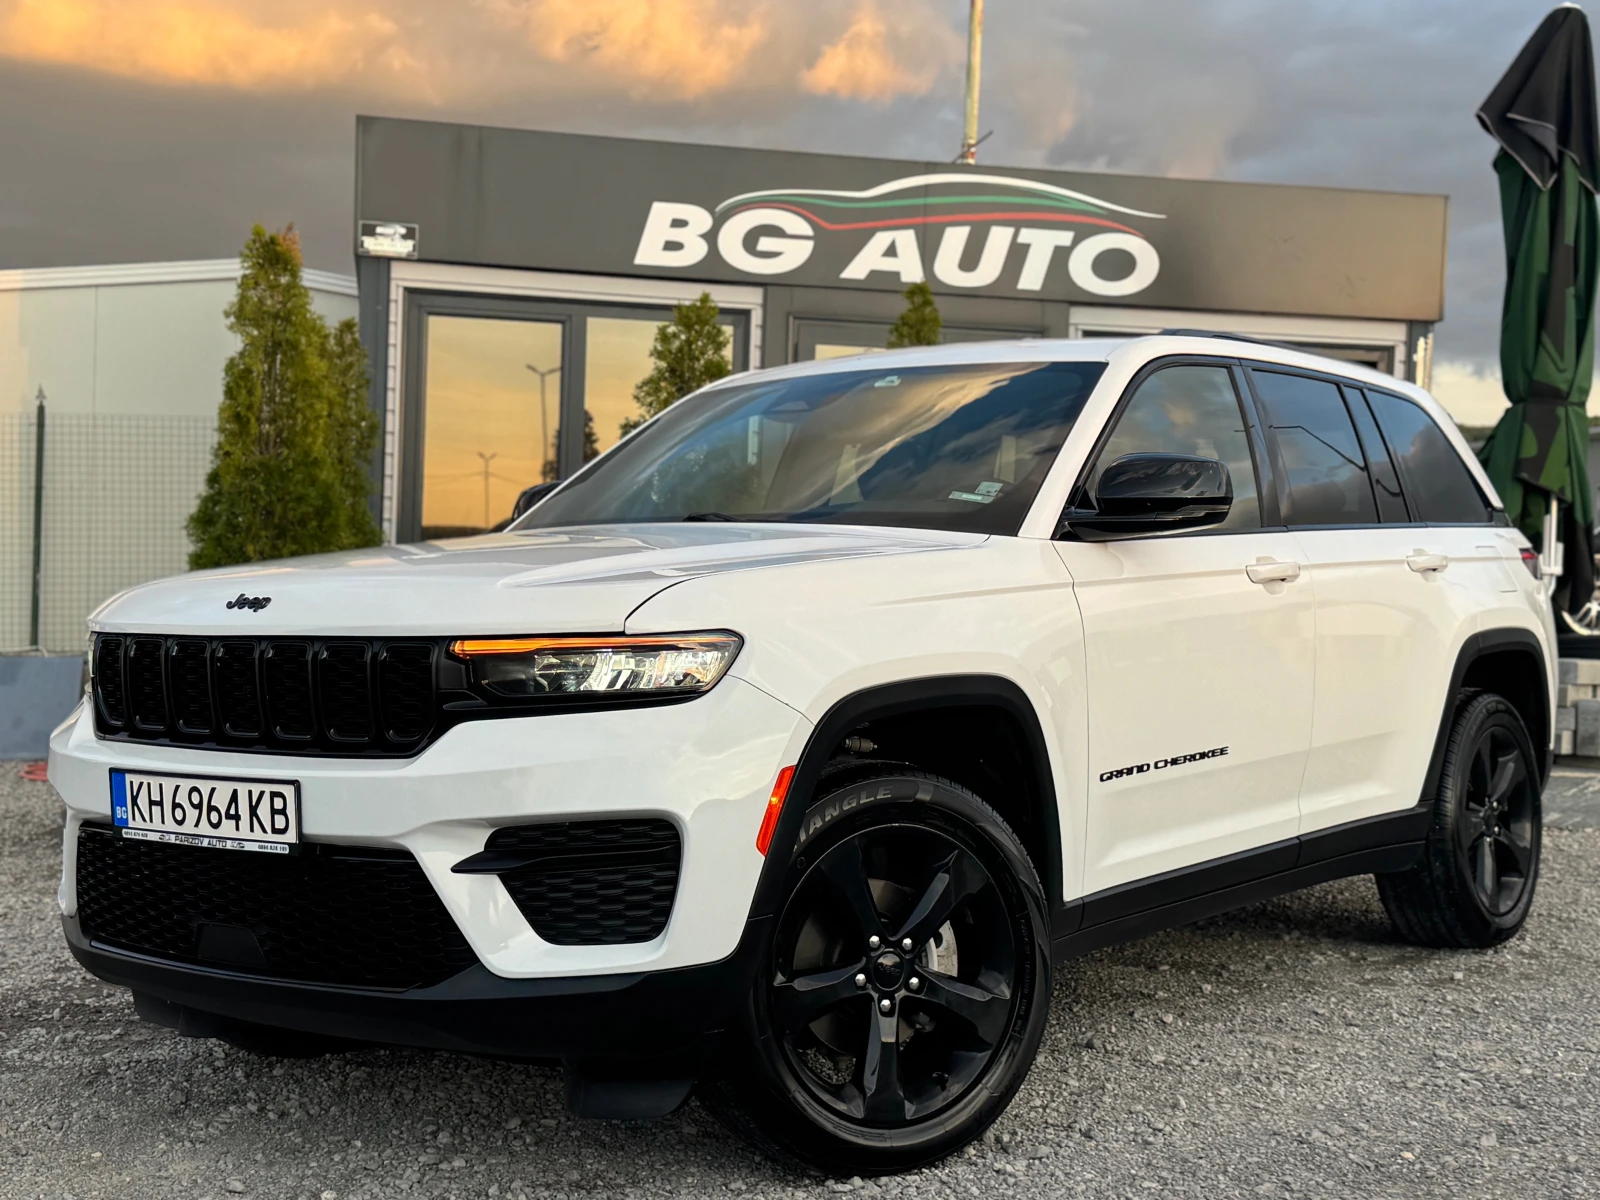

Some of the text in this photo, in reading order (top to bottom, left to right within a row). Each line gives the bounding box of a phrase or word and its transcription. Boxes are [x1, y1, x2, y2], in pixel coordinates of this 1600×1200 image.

[633, 201, 1160, 297] BG AUTO
[226, 593, 272, 613] Jeep
[1099, 746, 1229, 783] GRAND CHEROKEE
[116, 806, 128, 819] BG
[793, 785, 894, 852] IANGLE
[174, 835, 205, 846] PARIZOV
[207, 839, 228, 848] AUTO
